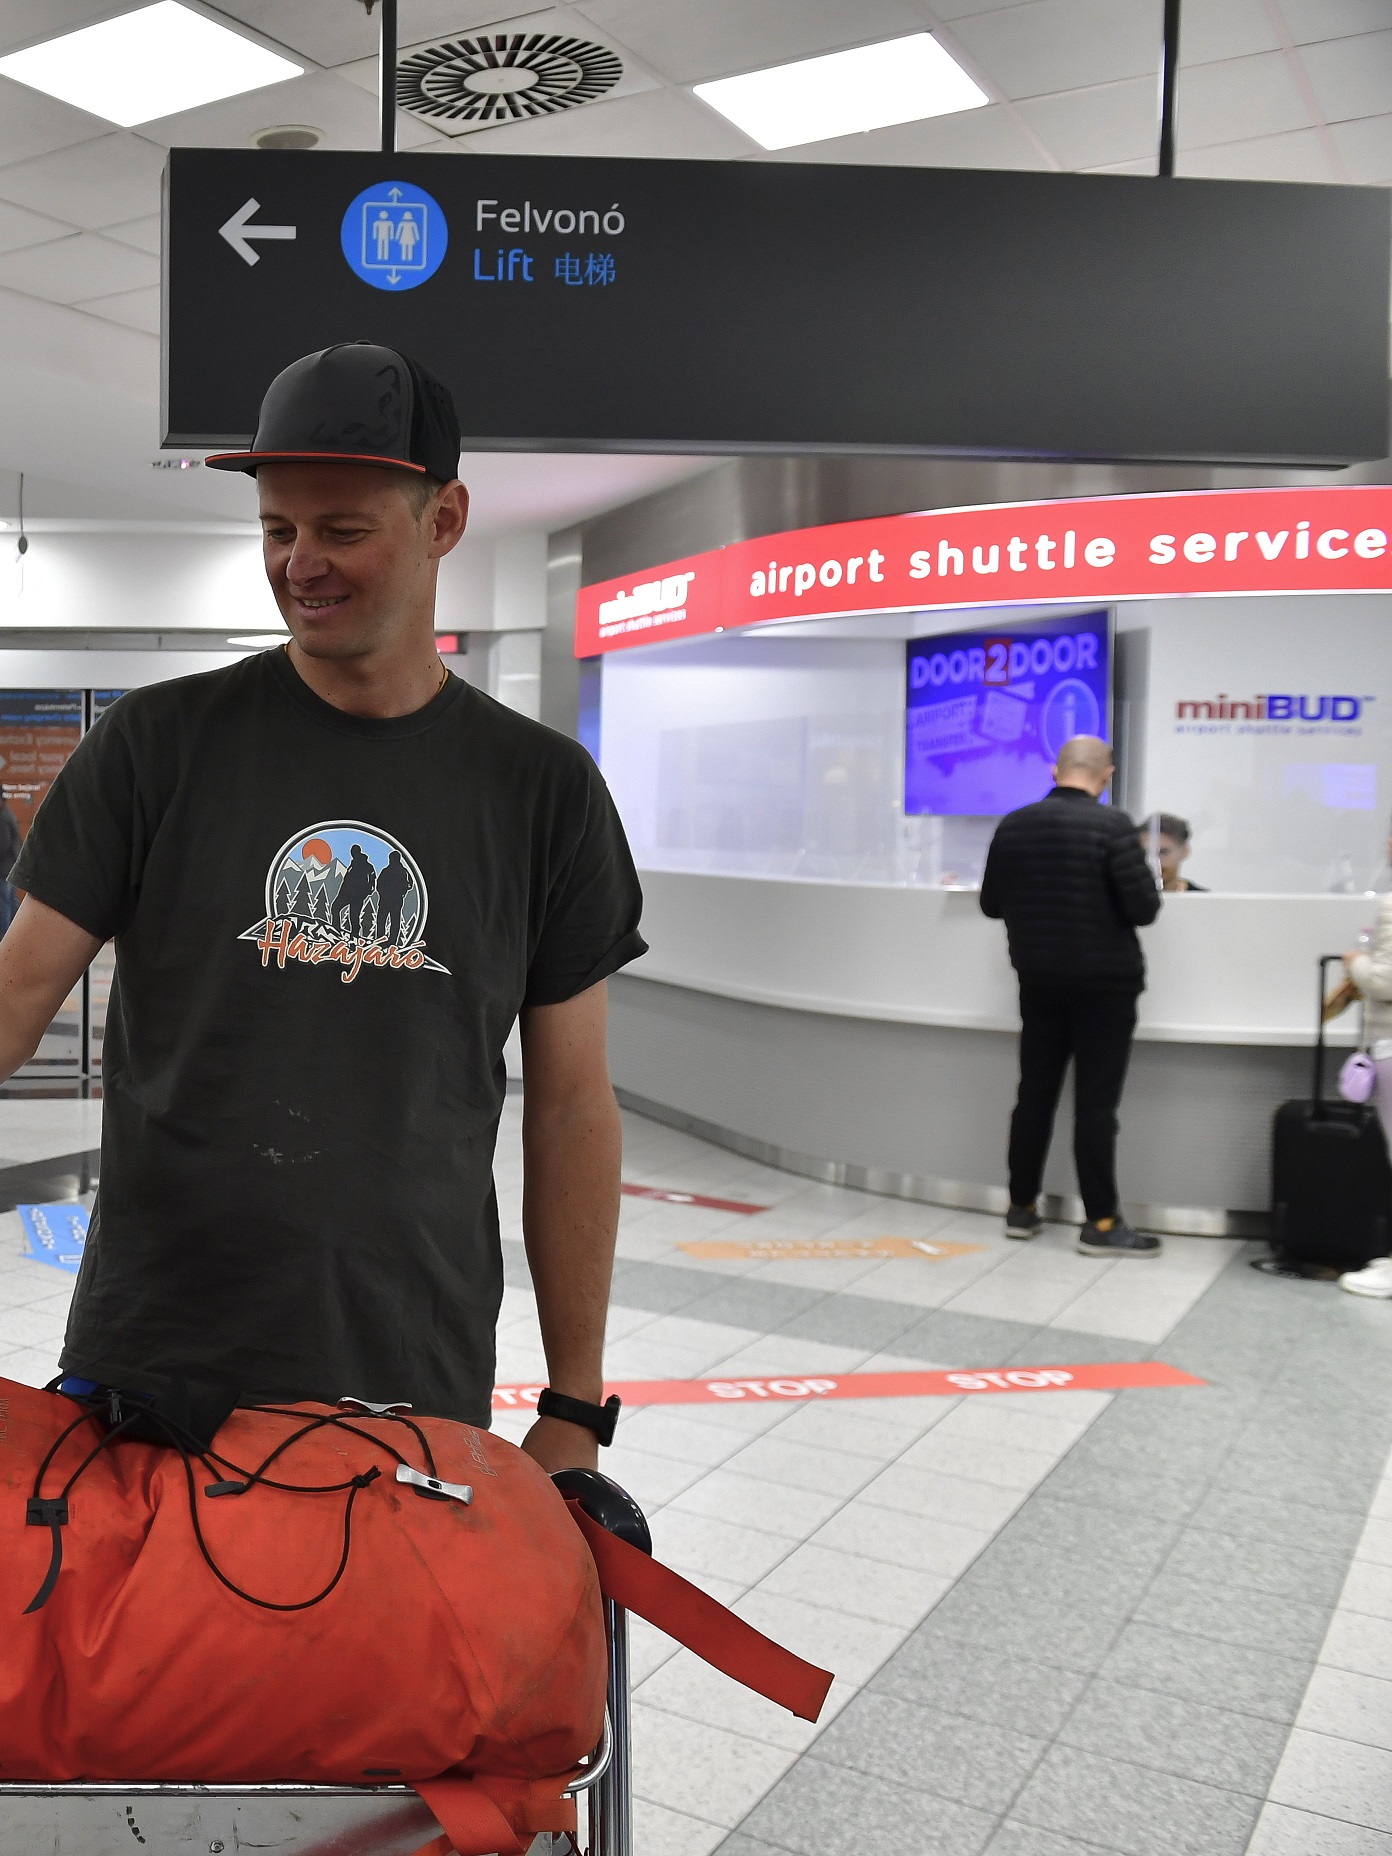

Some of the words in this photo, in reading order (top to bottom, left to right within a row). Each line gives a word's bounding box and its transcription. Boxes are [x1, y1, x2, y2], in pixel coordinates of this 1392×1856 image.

[476, 200, 626, 236] Felvonó
[473, 248, 534, 281] Lift
[554, 251, 616, 287] 电梯
[749, 549, 885, 597] airport
[909, 530, 1116, 579] shuttle
[1149, 520, 1392, 565] service
[257, 918, 427, 983] Hazajáró
[708, 1378, 838, 1399] STOP
[946, 1369, 1074, 1391] STOP
